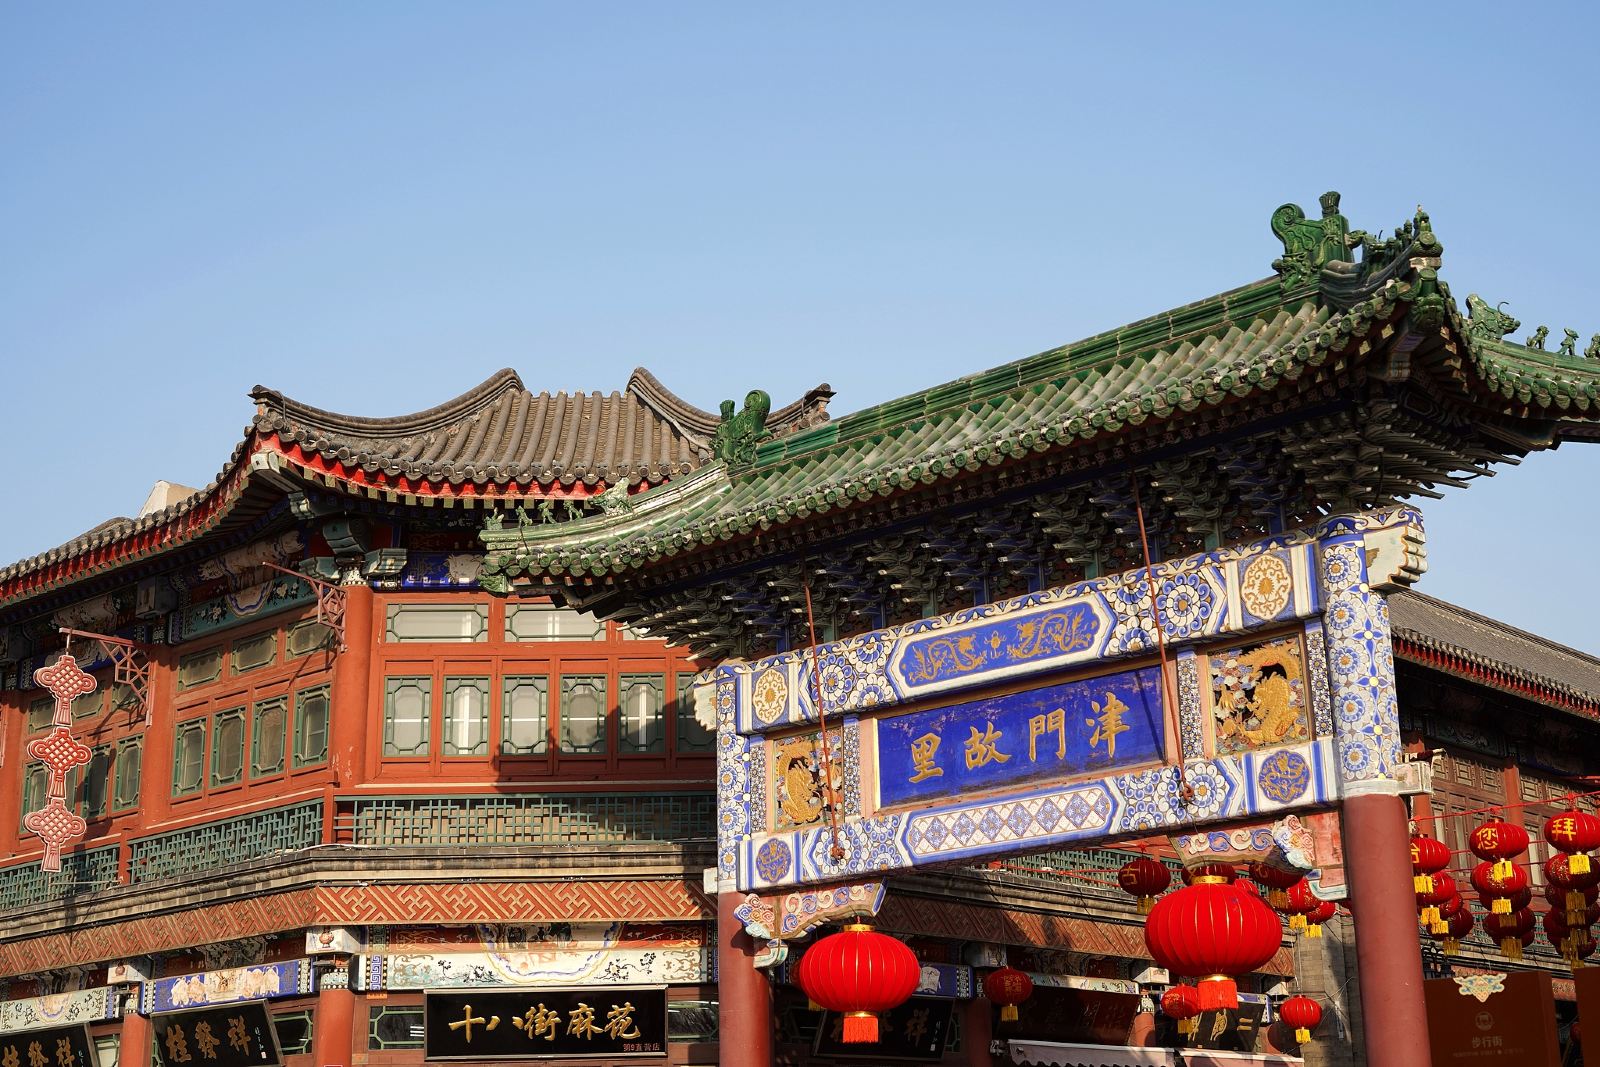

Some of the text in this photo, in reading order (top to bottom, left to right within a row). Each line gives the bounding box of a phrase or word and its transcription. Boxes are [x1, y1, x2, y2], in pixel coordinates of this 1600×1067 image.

[1476, 827, 1498, 850] 您
[1551, 818, 1577, 841] 拜
[448, 1001, 641, 1043] 十八街麻花
[1471, 1035, 1503, 1049] 步行街
